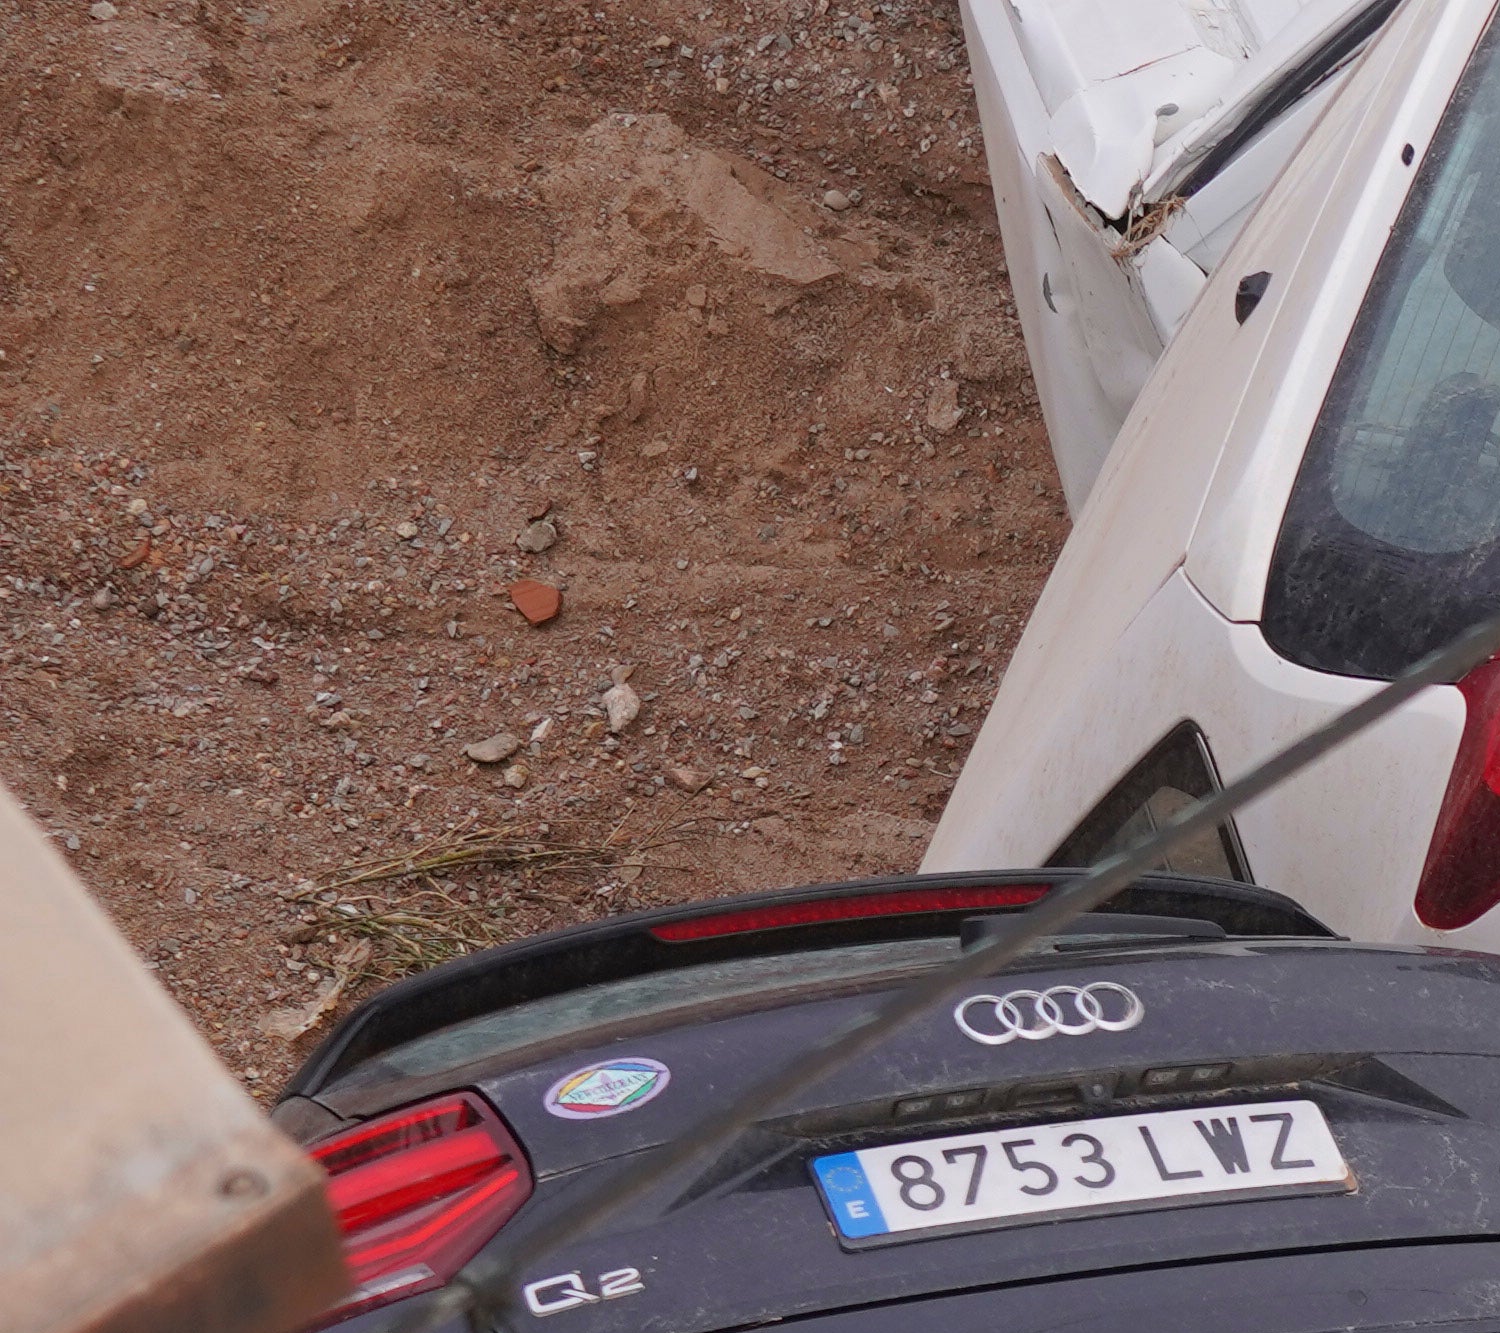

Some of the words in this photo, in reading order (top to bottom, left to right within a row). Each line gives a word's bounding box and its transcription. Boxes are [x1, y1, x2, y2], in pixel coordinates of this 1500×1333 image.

[889, 1132, 1118, 1213] 8753
[1137, 1112, 1317, 1183] LWZ
[523, 1266, 647, 1318] Q2
